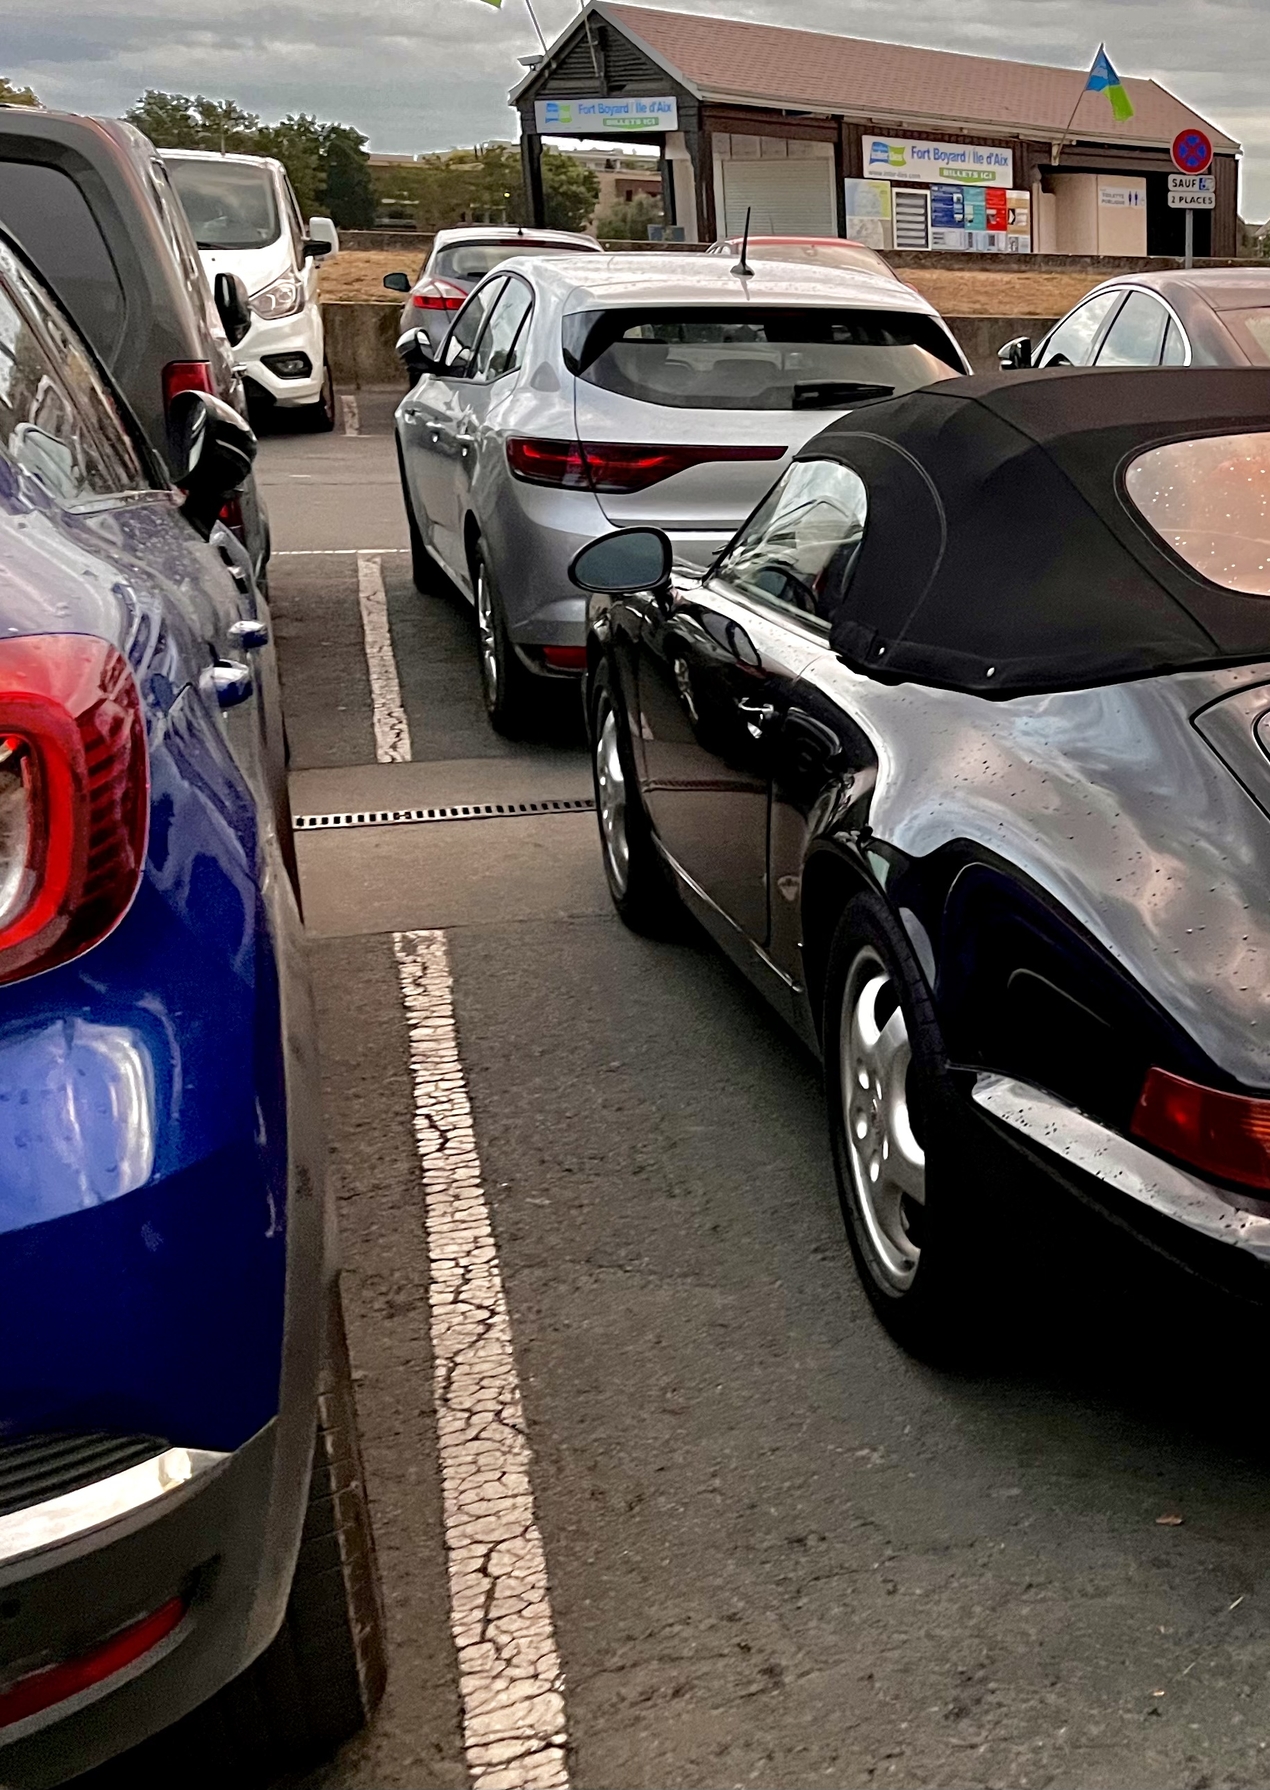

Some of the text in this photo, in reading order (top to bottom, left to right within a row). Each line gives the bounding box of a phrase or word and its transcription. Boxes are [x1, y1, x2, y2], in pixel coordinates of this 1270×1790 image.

[578, 103, 596, 115] Fort
[598, 103, 630, 117] Boyard
[649, 101, 672, 113] d'Aix
[911, 146, 931, 161] Fort
[933, 148, 966, 165] Boyard
[986, 152, 1009, 166] d'Aix
[943, 168, 992, 179] BILLETS ICI
[1172, 178, 1197, 188] SAUF
[1179, 196, 1213, 205] PLACES
